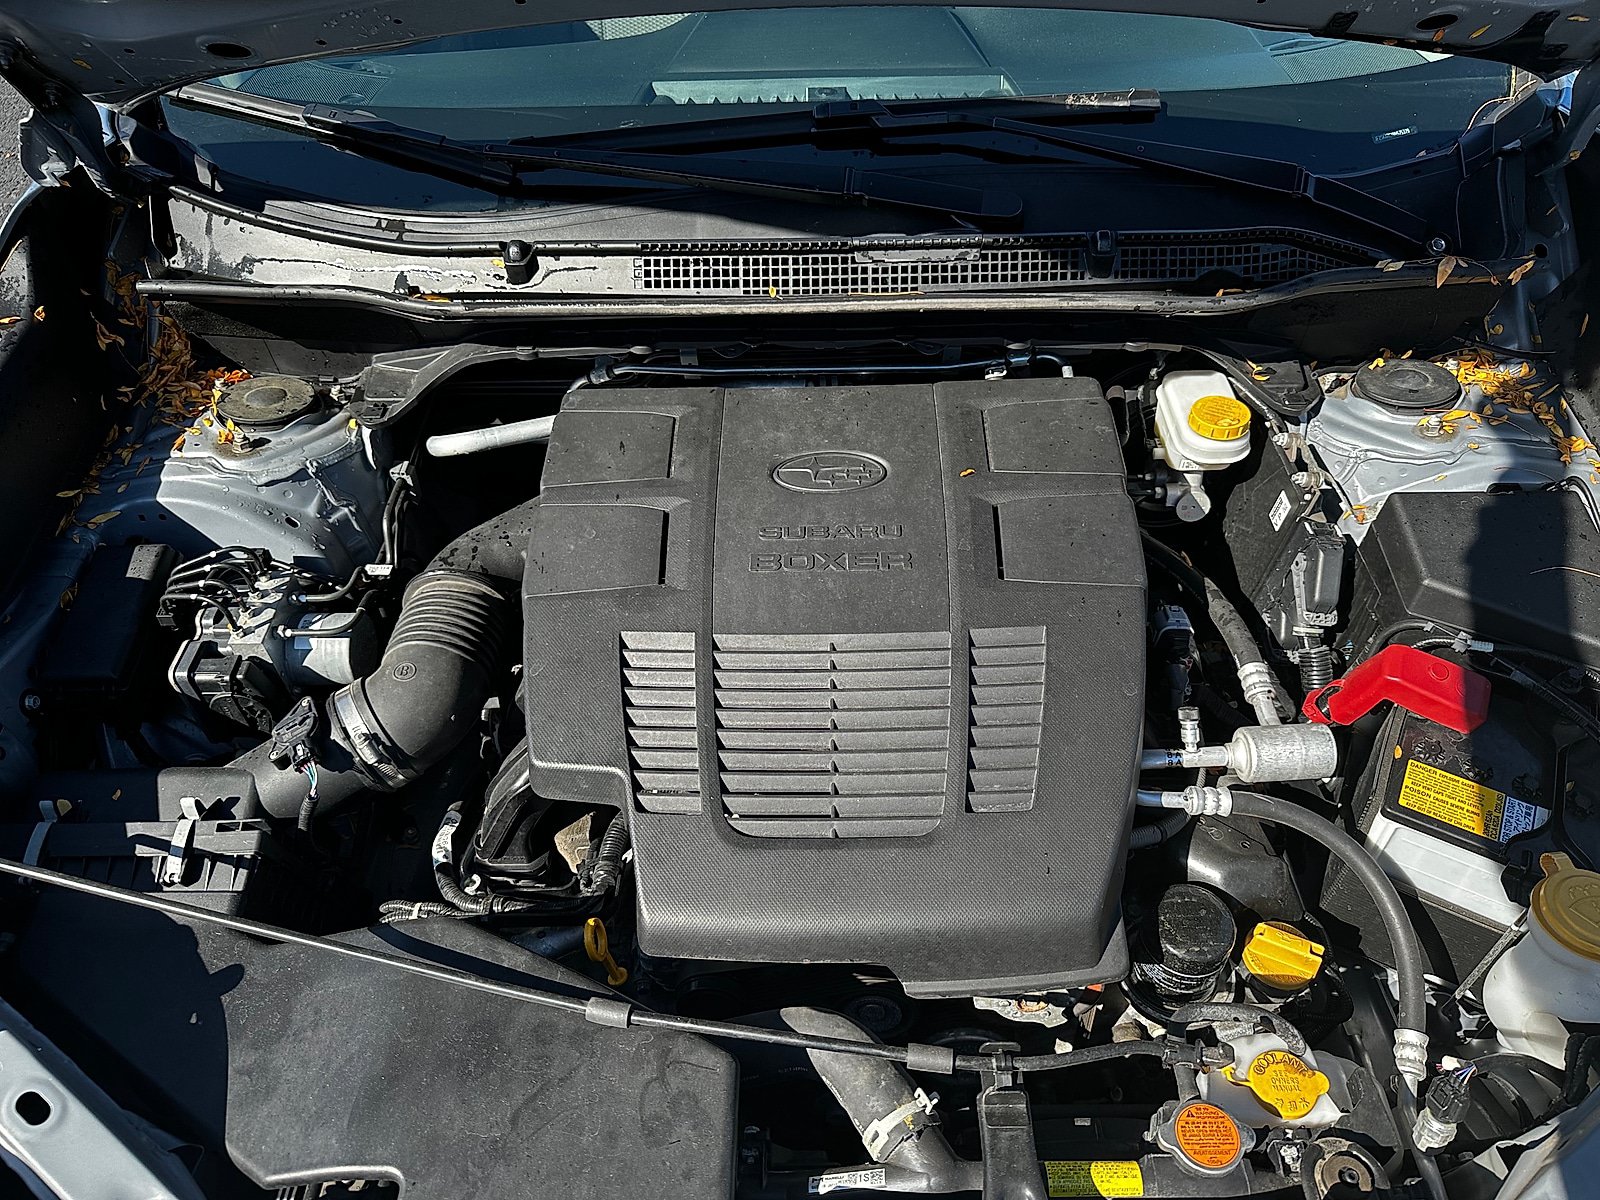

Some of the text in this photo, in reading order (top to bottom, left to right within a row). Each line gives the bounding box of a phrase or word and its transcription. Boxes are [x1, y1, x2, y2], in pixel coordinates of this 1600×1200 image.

[758, 524, 903, 541] SUBARU
[748, 551, 914, 572] BOXER
[1410, 762, 1438, 776] DANGER
[1405, 785, 1432, 799] POISON
[1503, 818, 1513, 832] STOP
[1253, 1052, 1309, 1075] COOLANT
